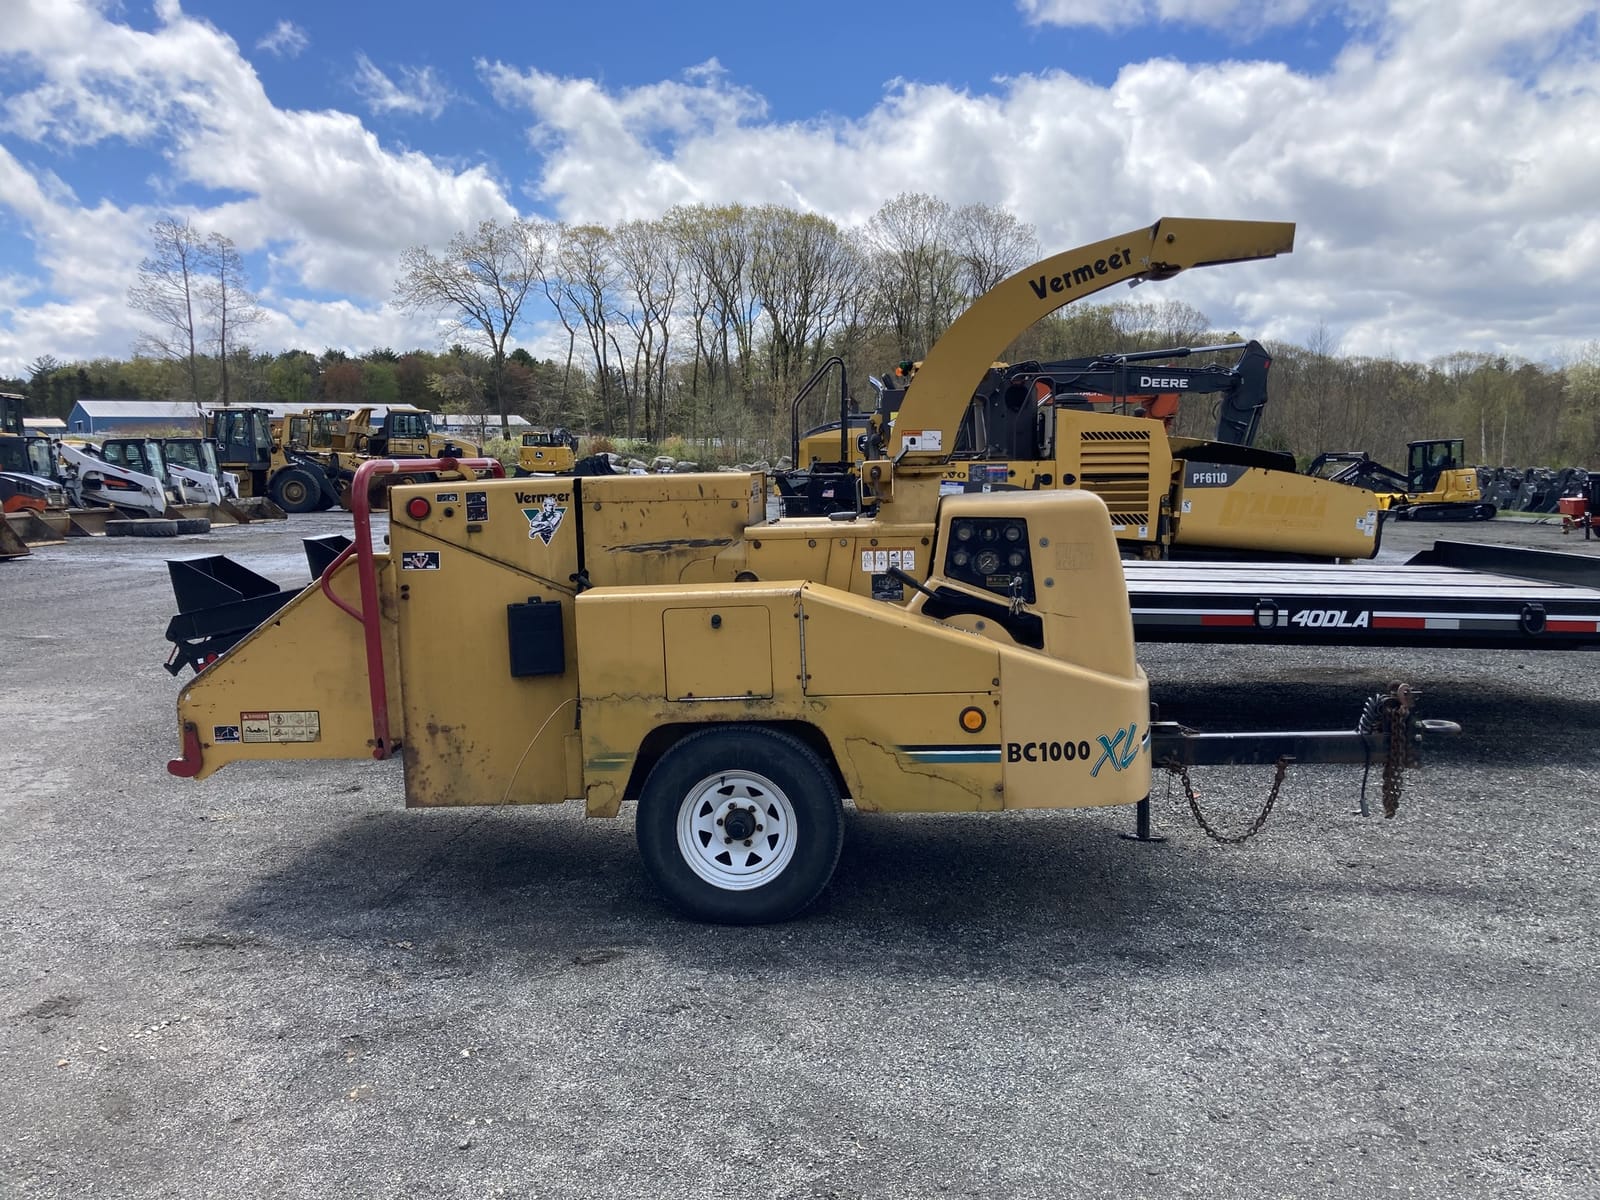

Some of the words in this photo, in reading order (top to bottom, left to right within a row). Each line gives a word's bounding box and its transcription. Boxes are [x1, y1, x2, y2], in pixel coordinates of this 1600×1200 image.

[1028, 247, 1132, 300] Vermeer
[1140, 376, 1189, 388] DEERE
[1192, 472, 1228, 484] PF6110
[1291, 609, 1369, 628] 40DLA
[1007, 740, 1091, 763] BC1000
[1090, 722, 1140, 777] XL
